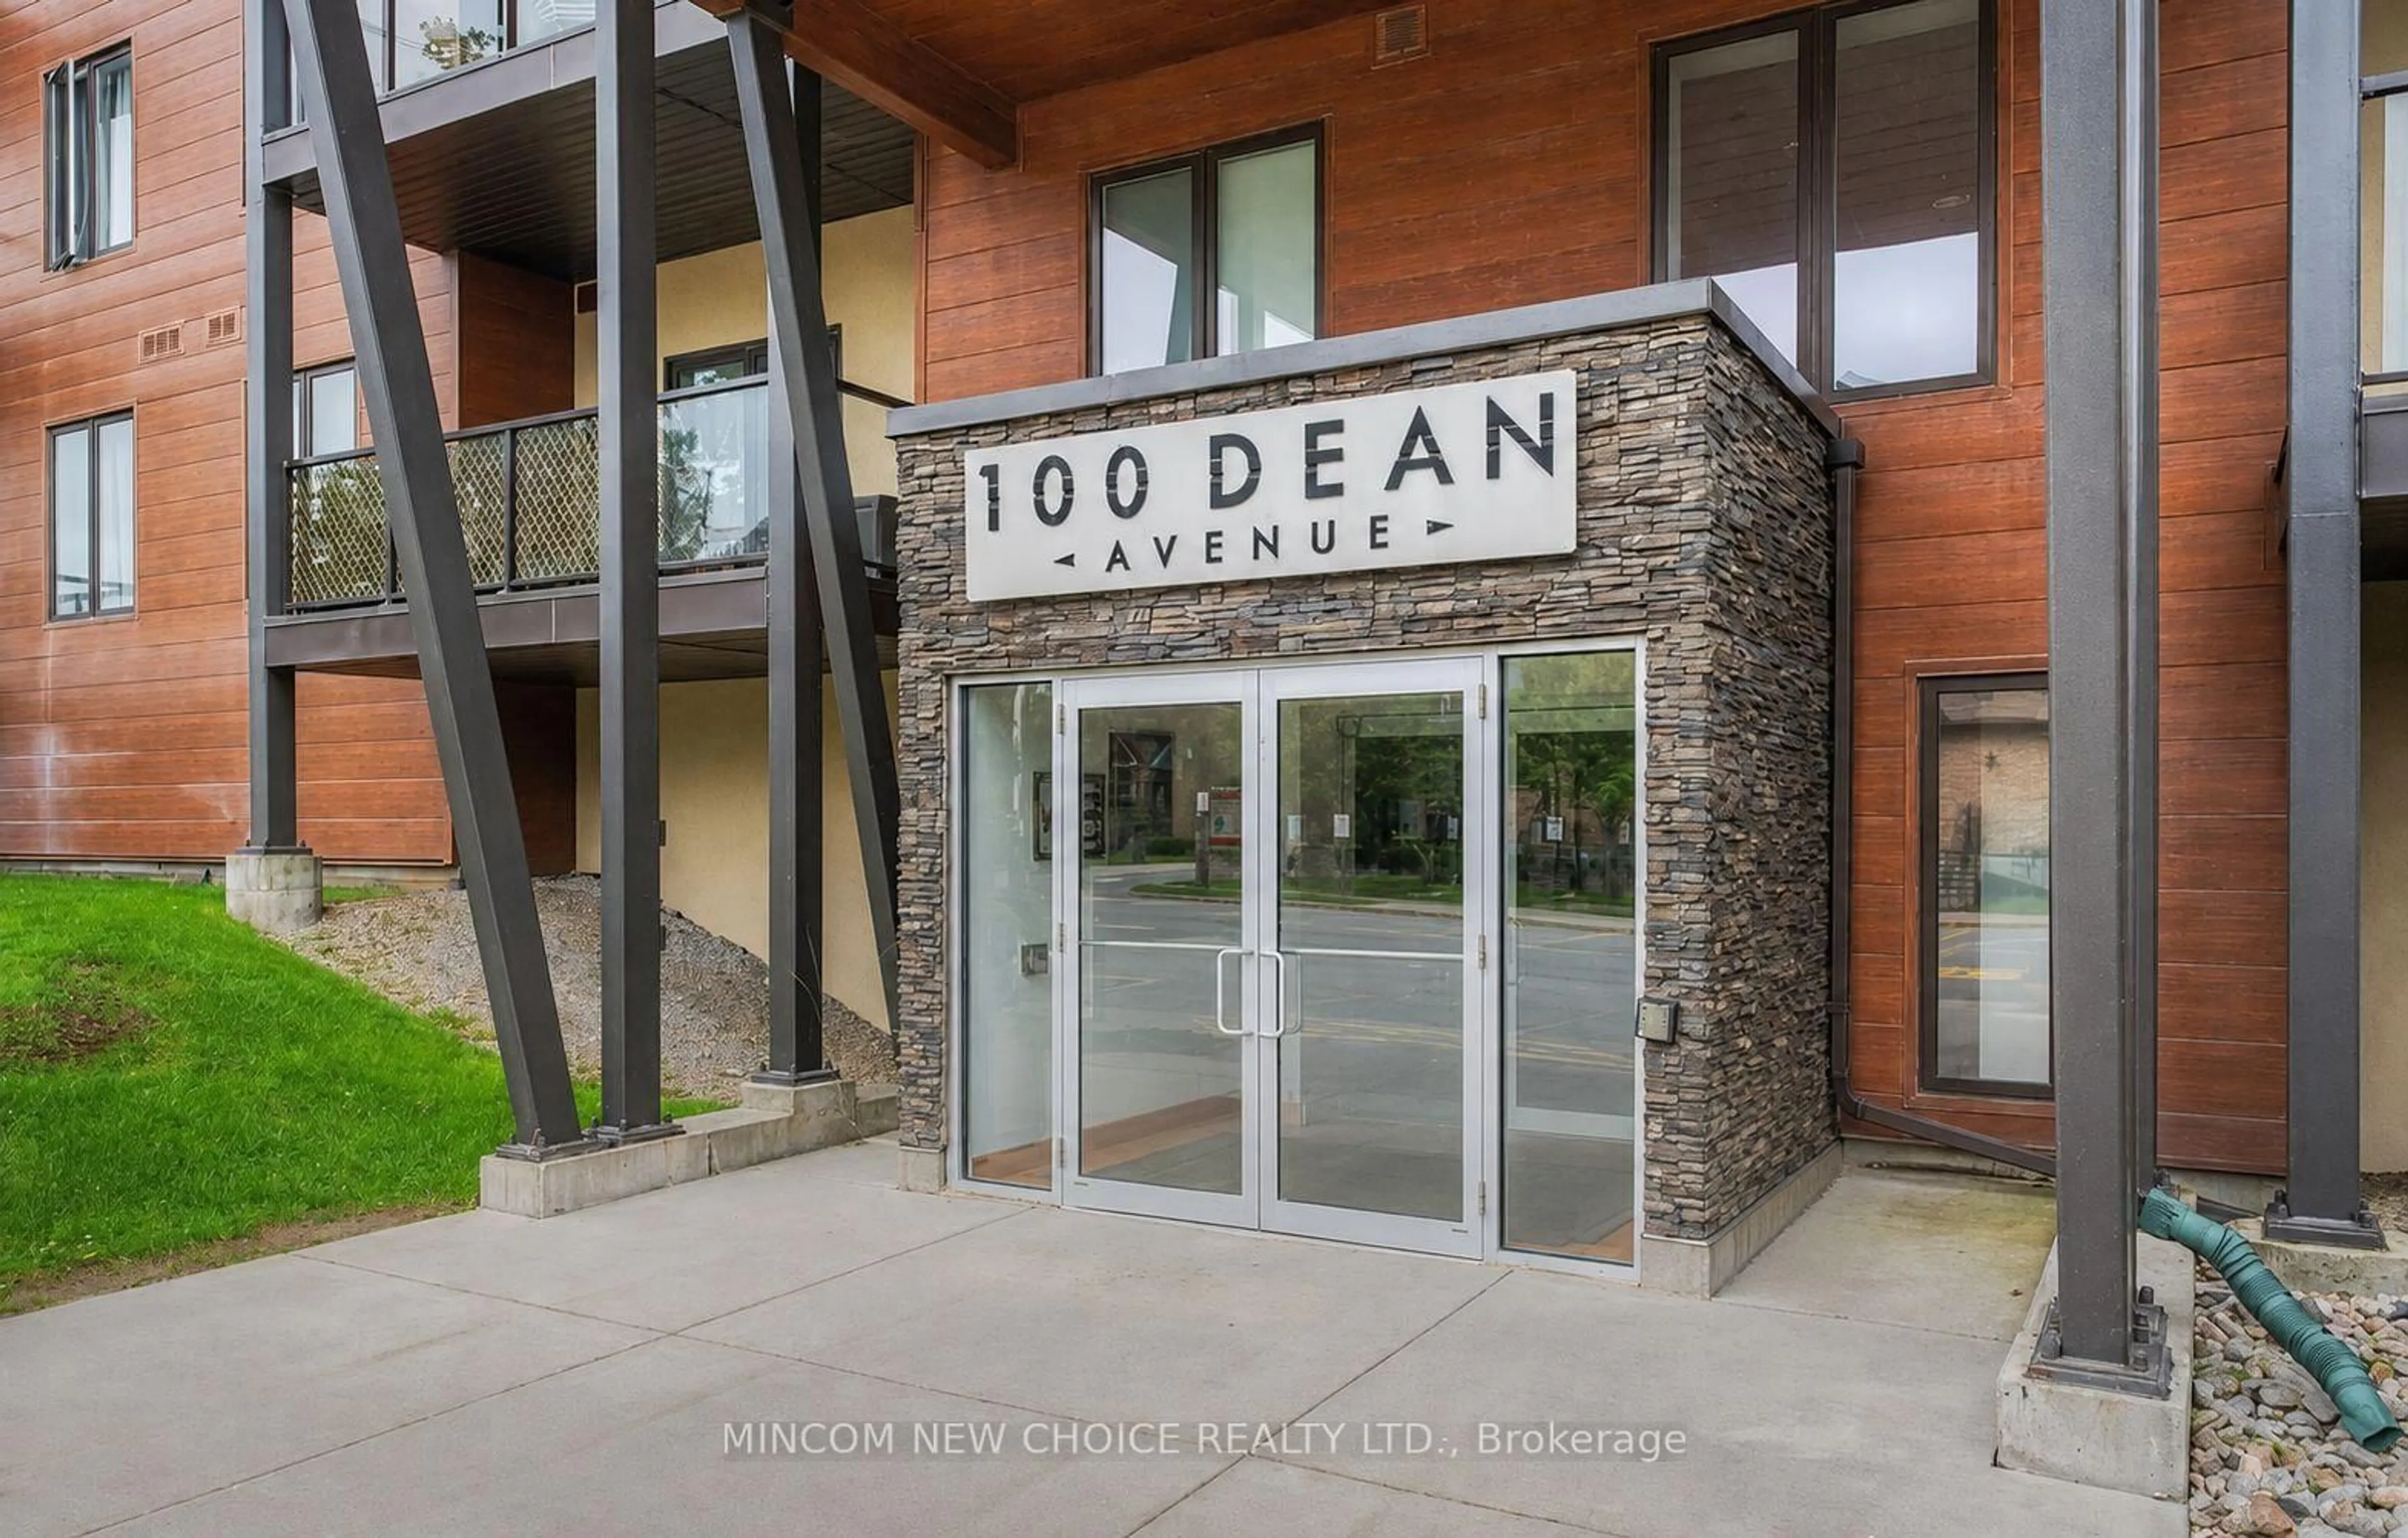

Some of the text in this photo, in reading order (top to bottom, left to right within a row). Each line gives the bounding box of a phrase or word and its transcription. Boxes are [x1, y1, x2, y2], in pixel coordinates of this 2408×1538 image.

[979, 393, 1554, 532] 100 DEAN
[1105, 514, 1388, 573] AVENUE
